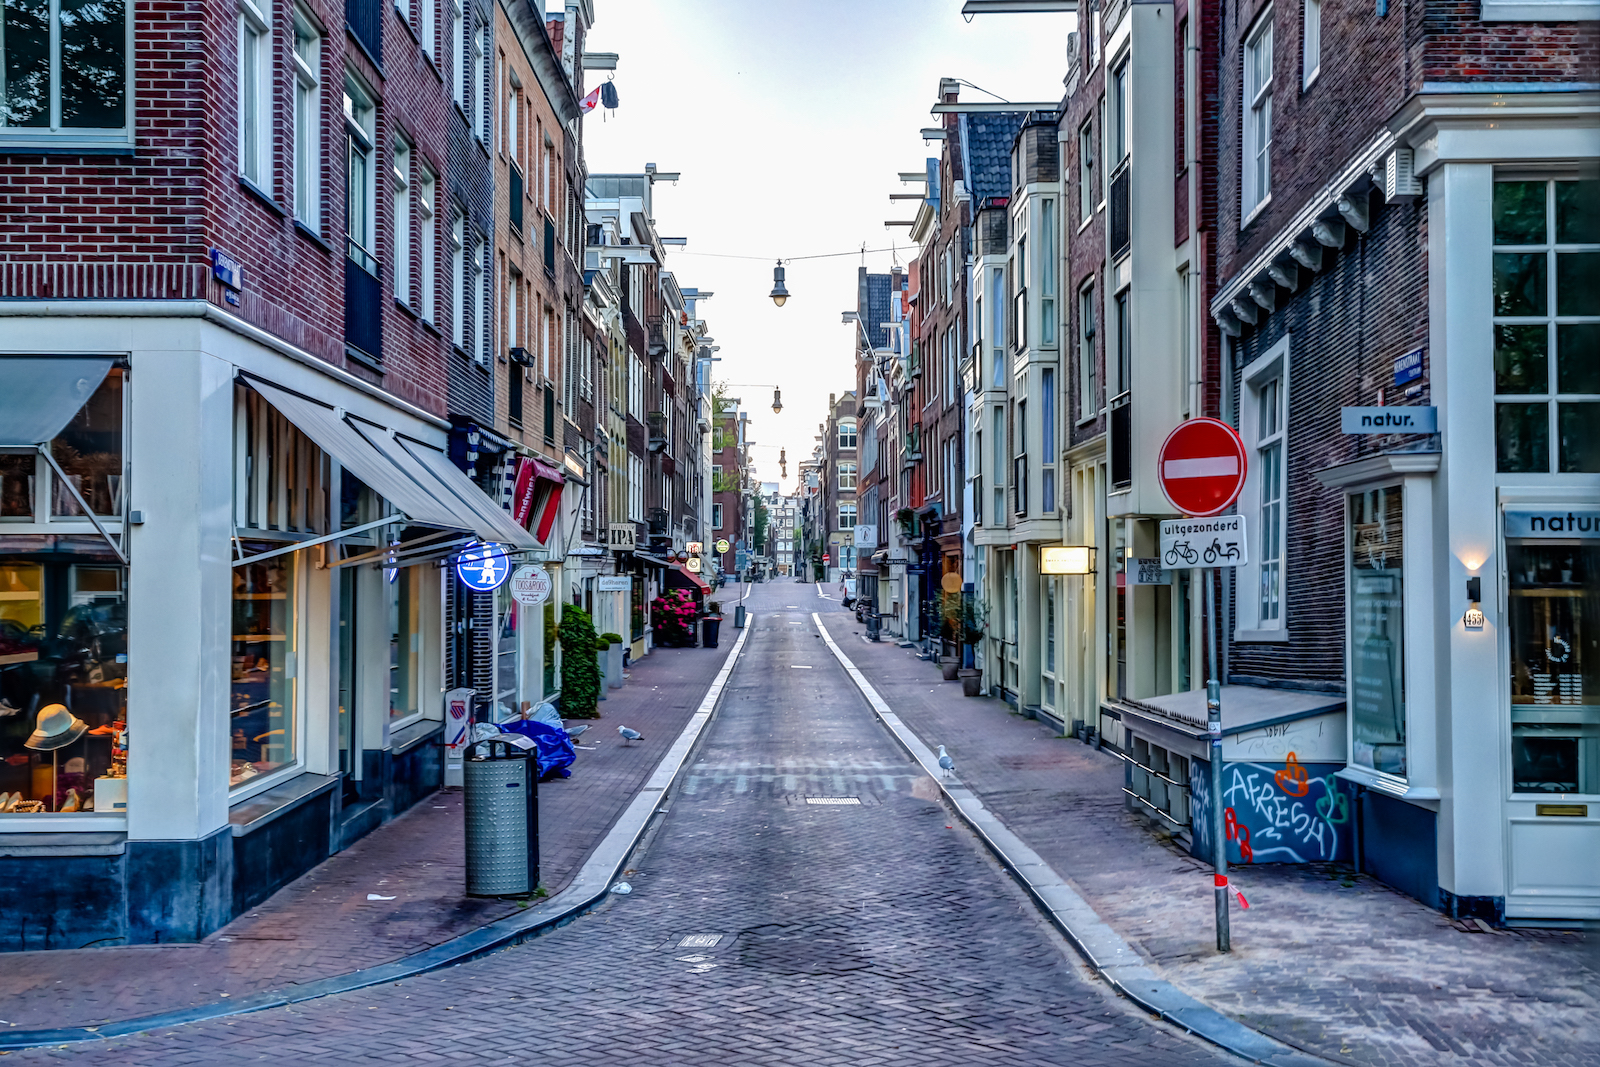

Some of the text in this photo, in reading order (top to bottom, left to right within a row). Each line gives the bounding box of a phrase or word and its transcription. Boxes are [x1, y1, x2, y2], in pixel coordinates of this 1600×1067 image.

[1361, 412, 1414, 426] natur.
[1164, 520, 1238, 537] uitgezonderd
[610, 530, 634, 545] IPA
[1467, 613, 1482, 625] 455
[1223, 768, 1325, 857] AFRESH
